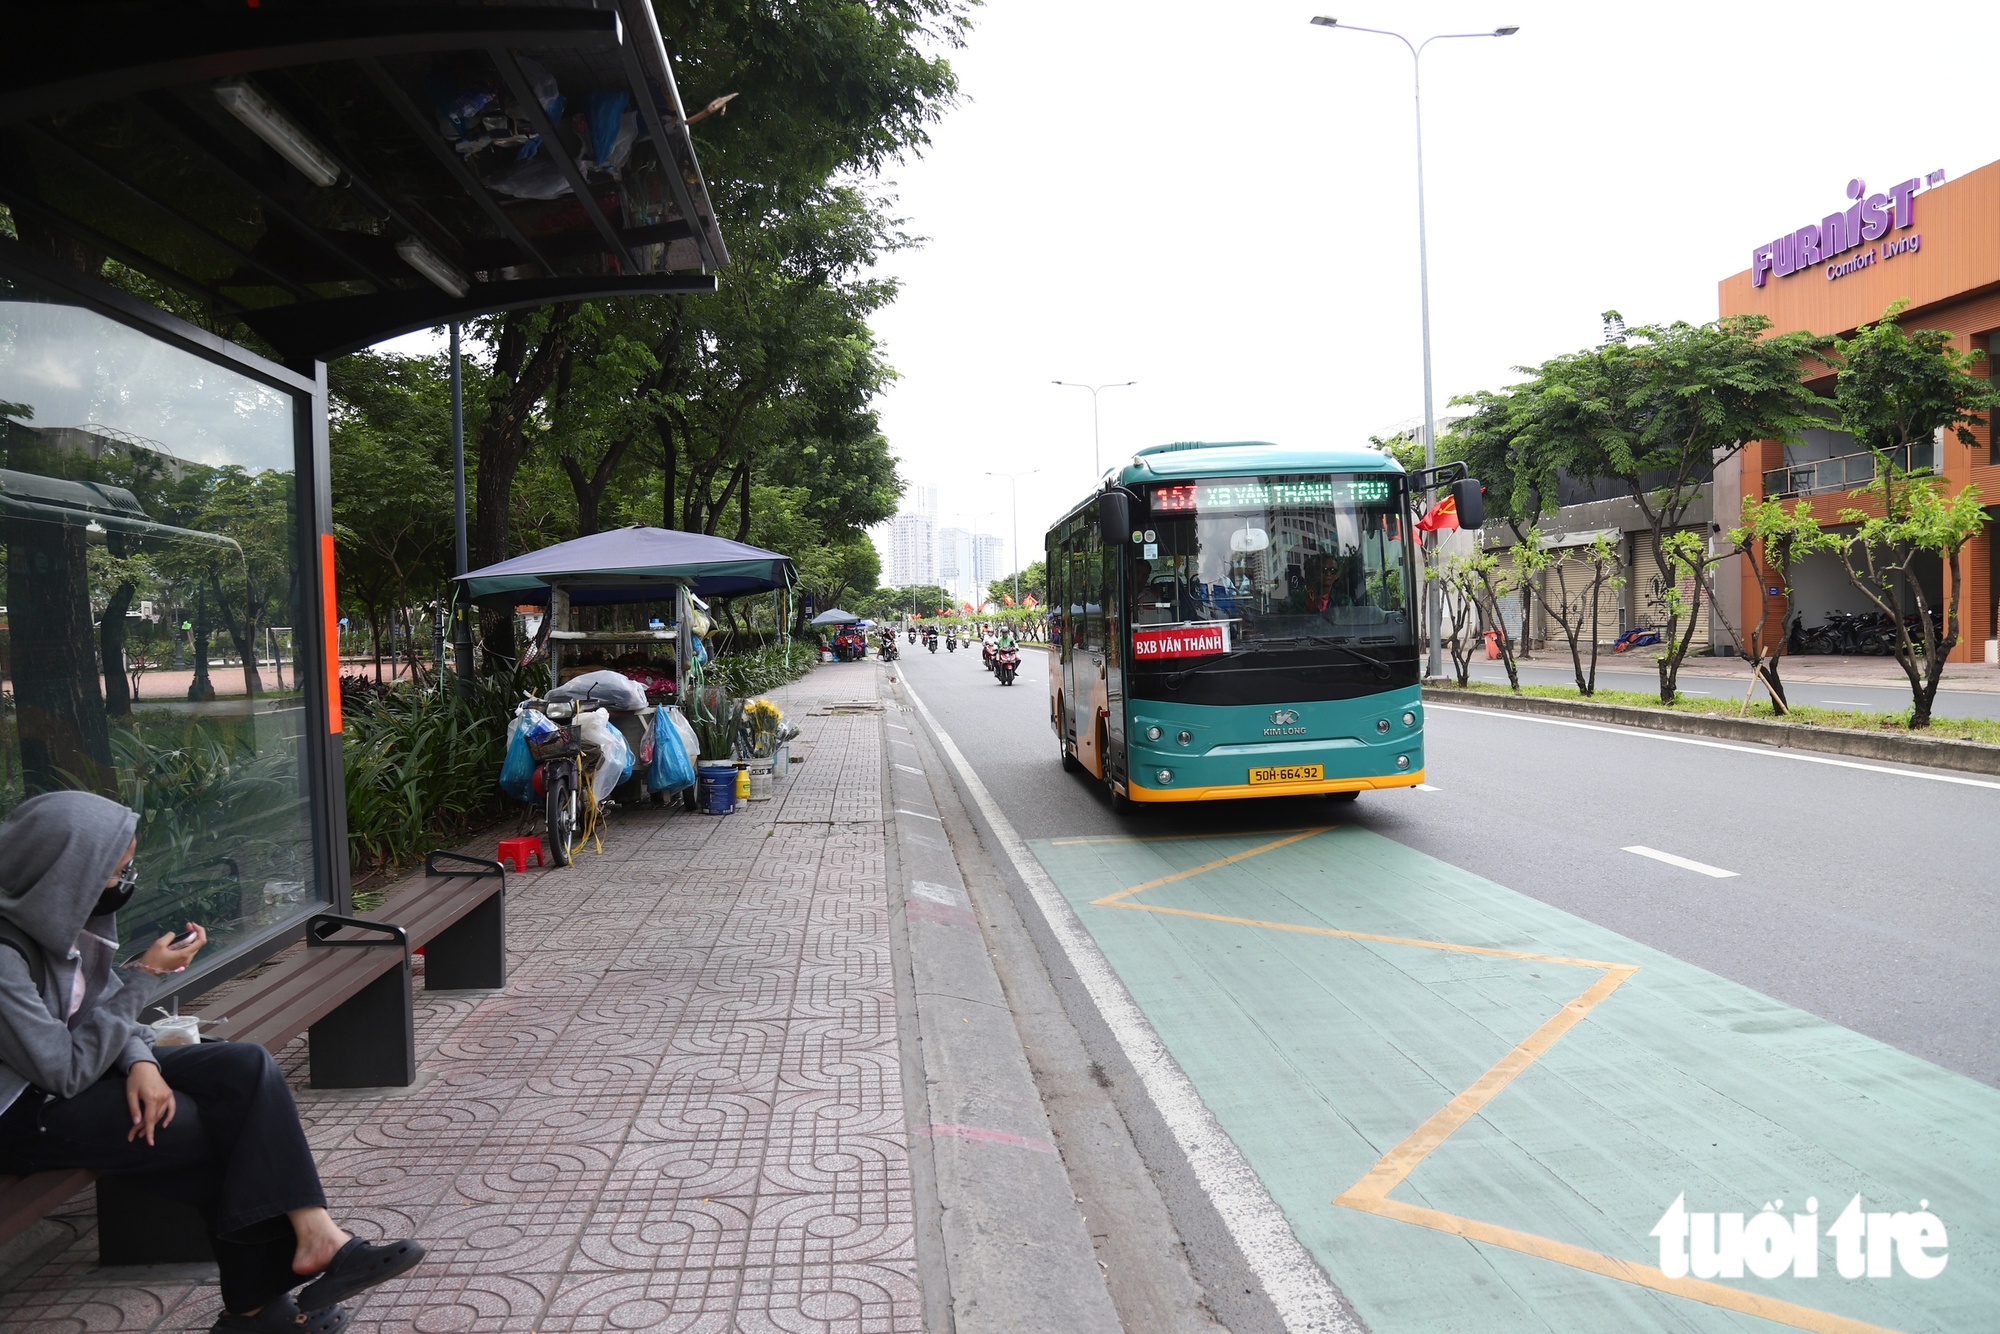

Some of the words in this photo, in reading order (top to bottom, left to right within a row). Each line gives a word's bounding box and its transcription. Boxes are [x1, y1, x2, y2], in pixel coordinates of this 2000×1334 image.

[1826, 248, 1876, 280] Comfort
[1881, 234, 1921, 260] Living
[1157, 485, 1198, 510] 157
[1136, 635, 1158, 655] BXB
[1159, 635, 1182, 653] VĂN
[1183, 634, 1221, 651] THÁNH
[1263, 728, 1281, 736] KIM
[1282, 727, 1307, 735] LONG
